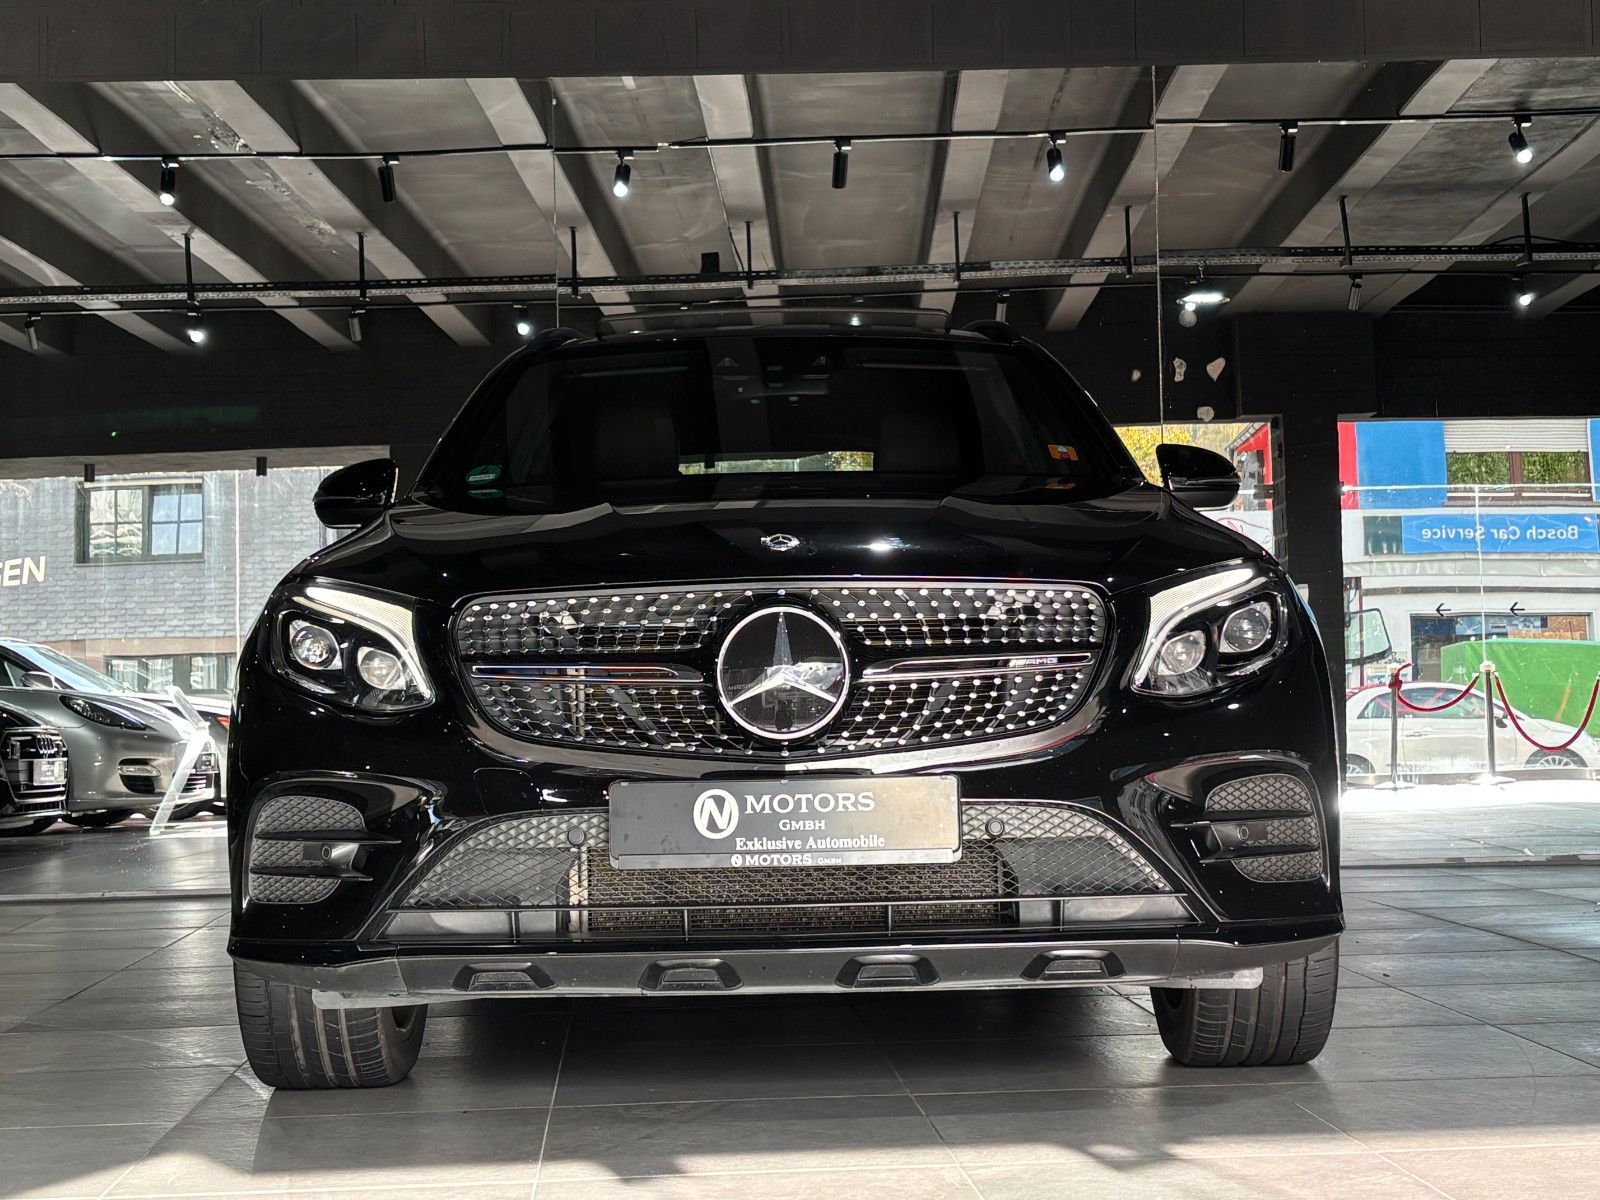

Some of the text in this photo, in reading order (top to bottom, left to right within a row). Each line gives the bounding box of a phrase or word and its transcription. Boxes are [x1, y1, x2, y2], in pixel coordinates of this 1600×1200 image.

[0, 556, 46, 586] EN
[744, 791, 876, 814] MOTORS
[778, 819, 826, 831] GMBH
[735, 834, 886, 851] Exklusive Automobile
[745, 853, 812, 866] MOTORS
